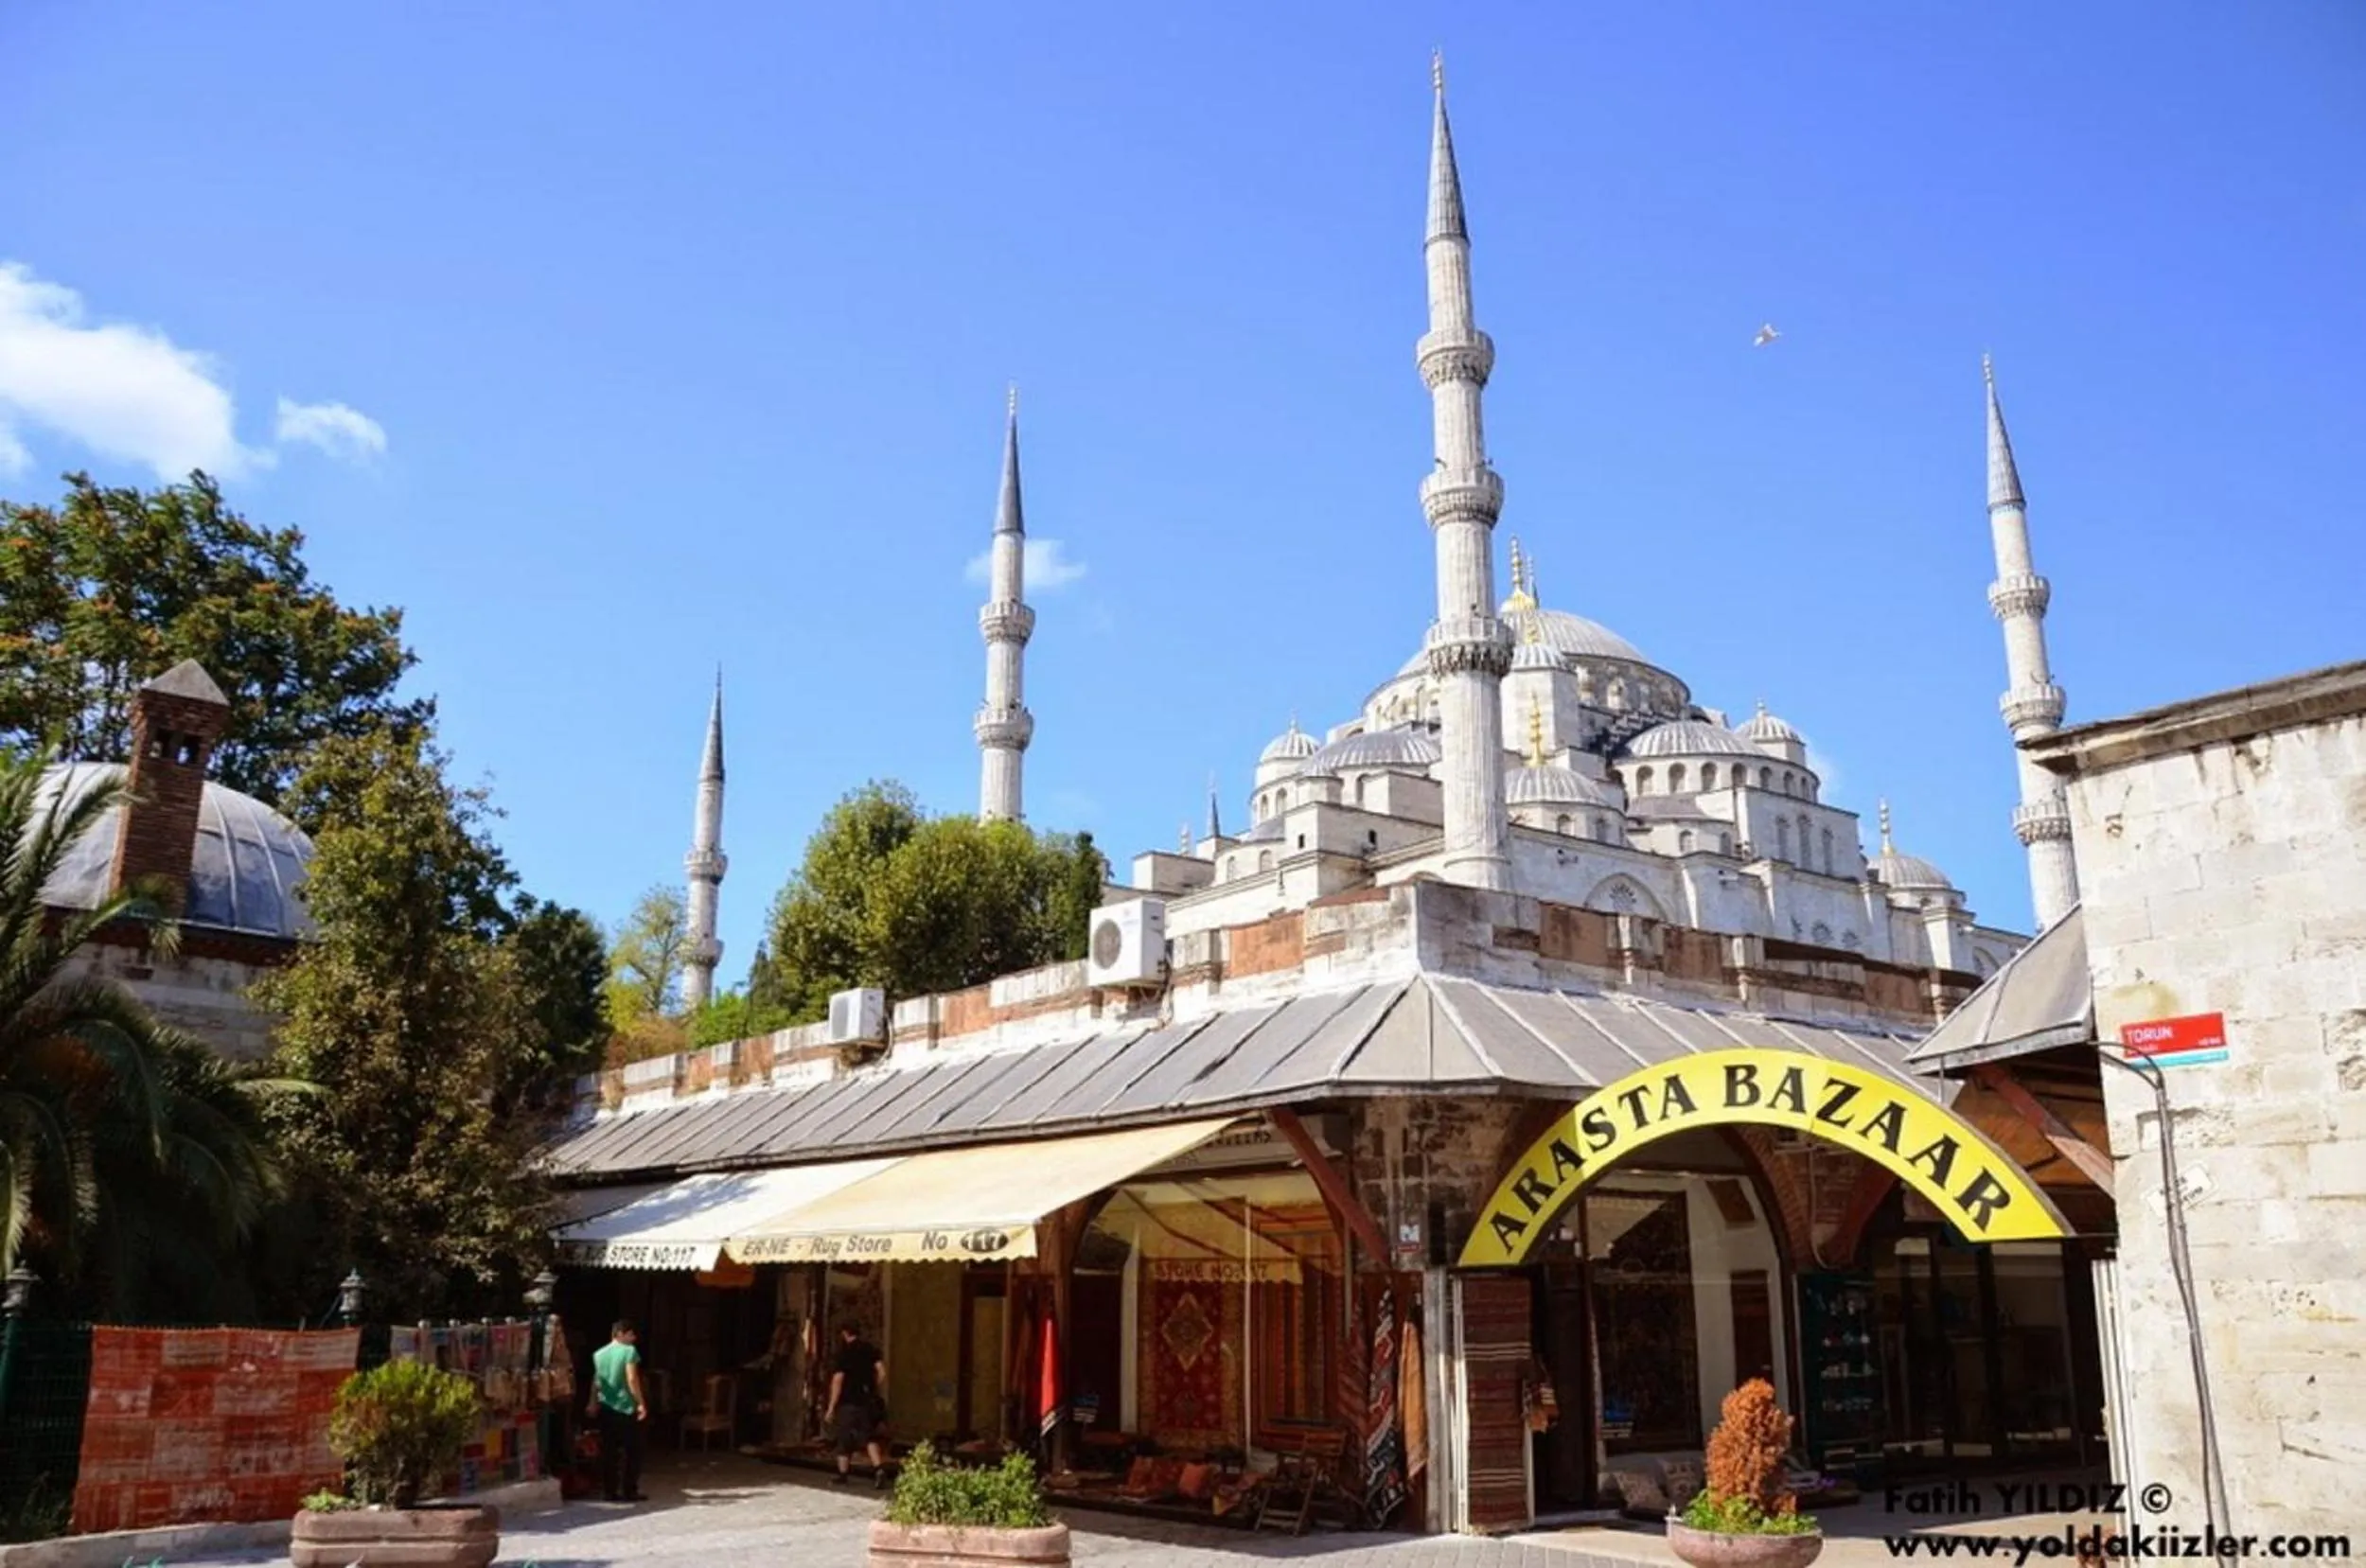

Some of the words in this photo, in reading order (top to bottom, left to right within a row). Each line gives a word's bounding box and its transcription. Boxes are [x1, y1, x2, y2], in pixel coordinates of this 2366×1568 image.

[1489, 1074, 1698, 1255] ARASTA
[1724, 1065, 2011, 1233] BAZAAR
[609, 1245, 650, 1263] STORE
[810, 1236, 841, 1260] Rug
[847, 1234, 892, 1254] Store
[922, 1230, 948, 1250] No
